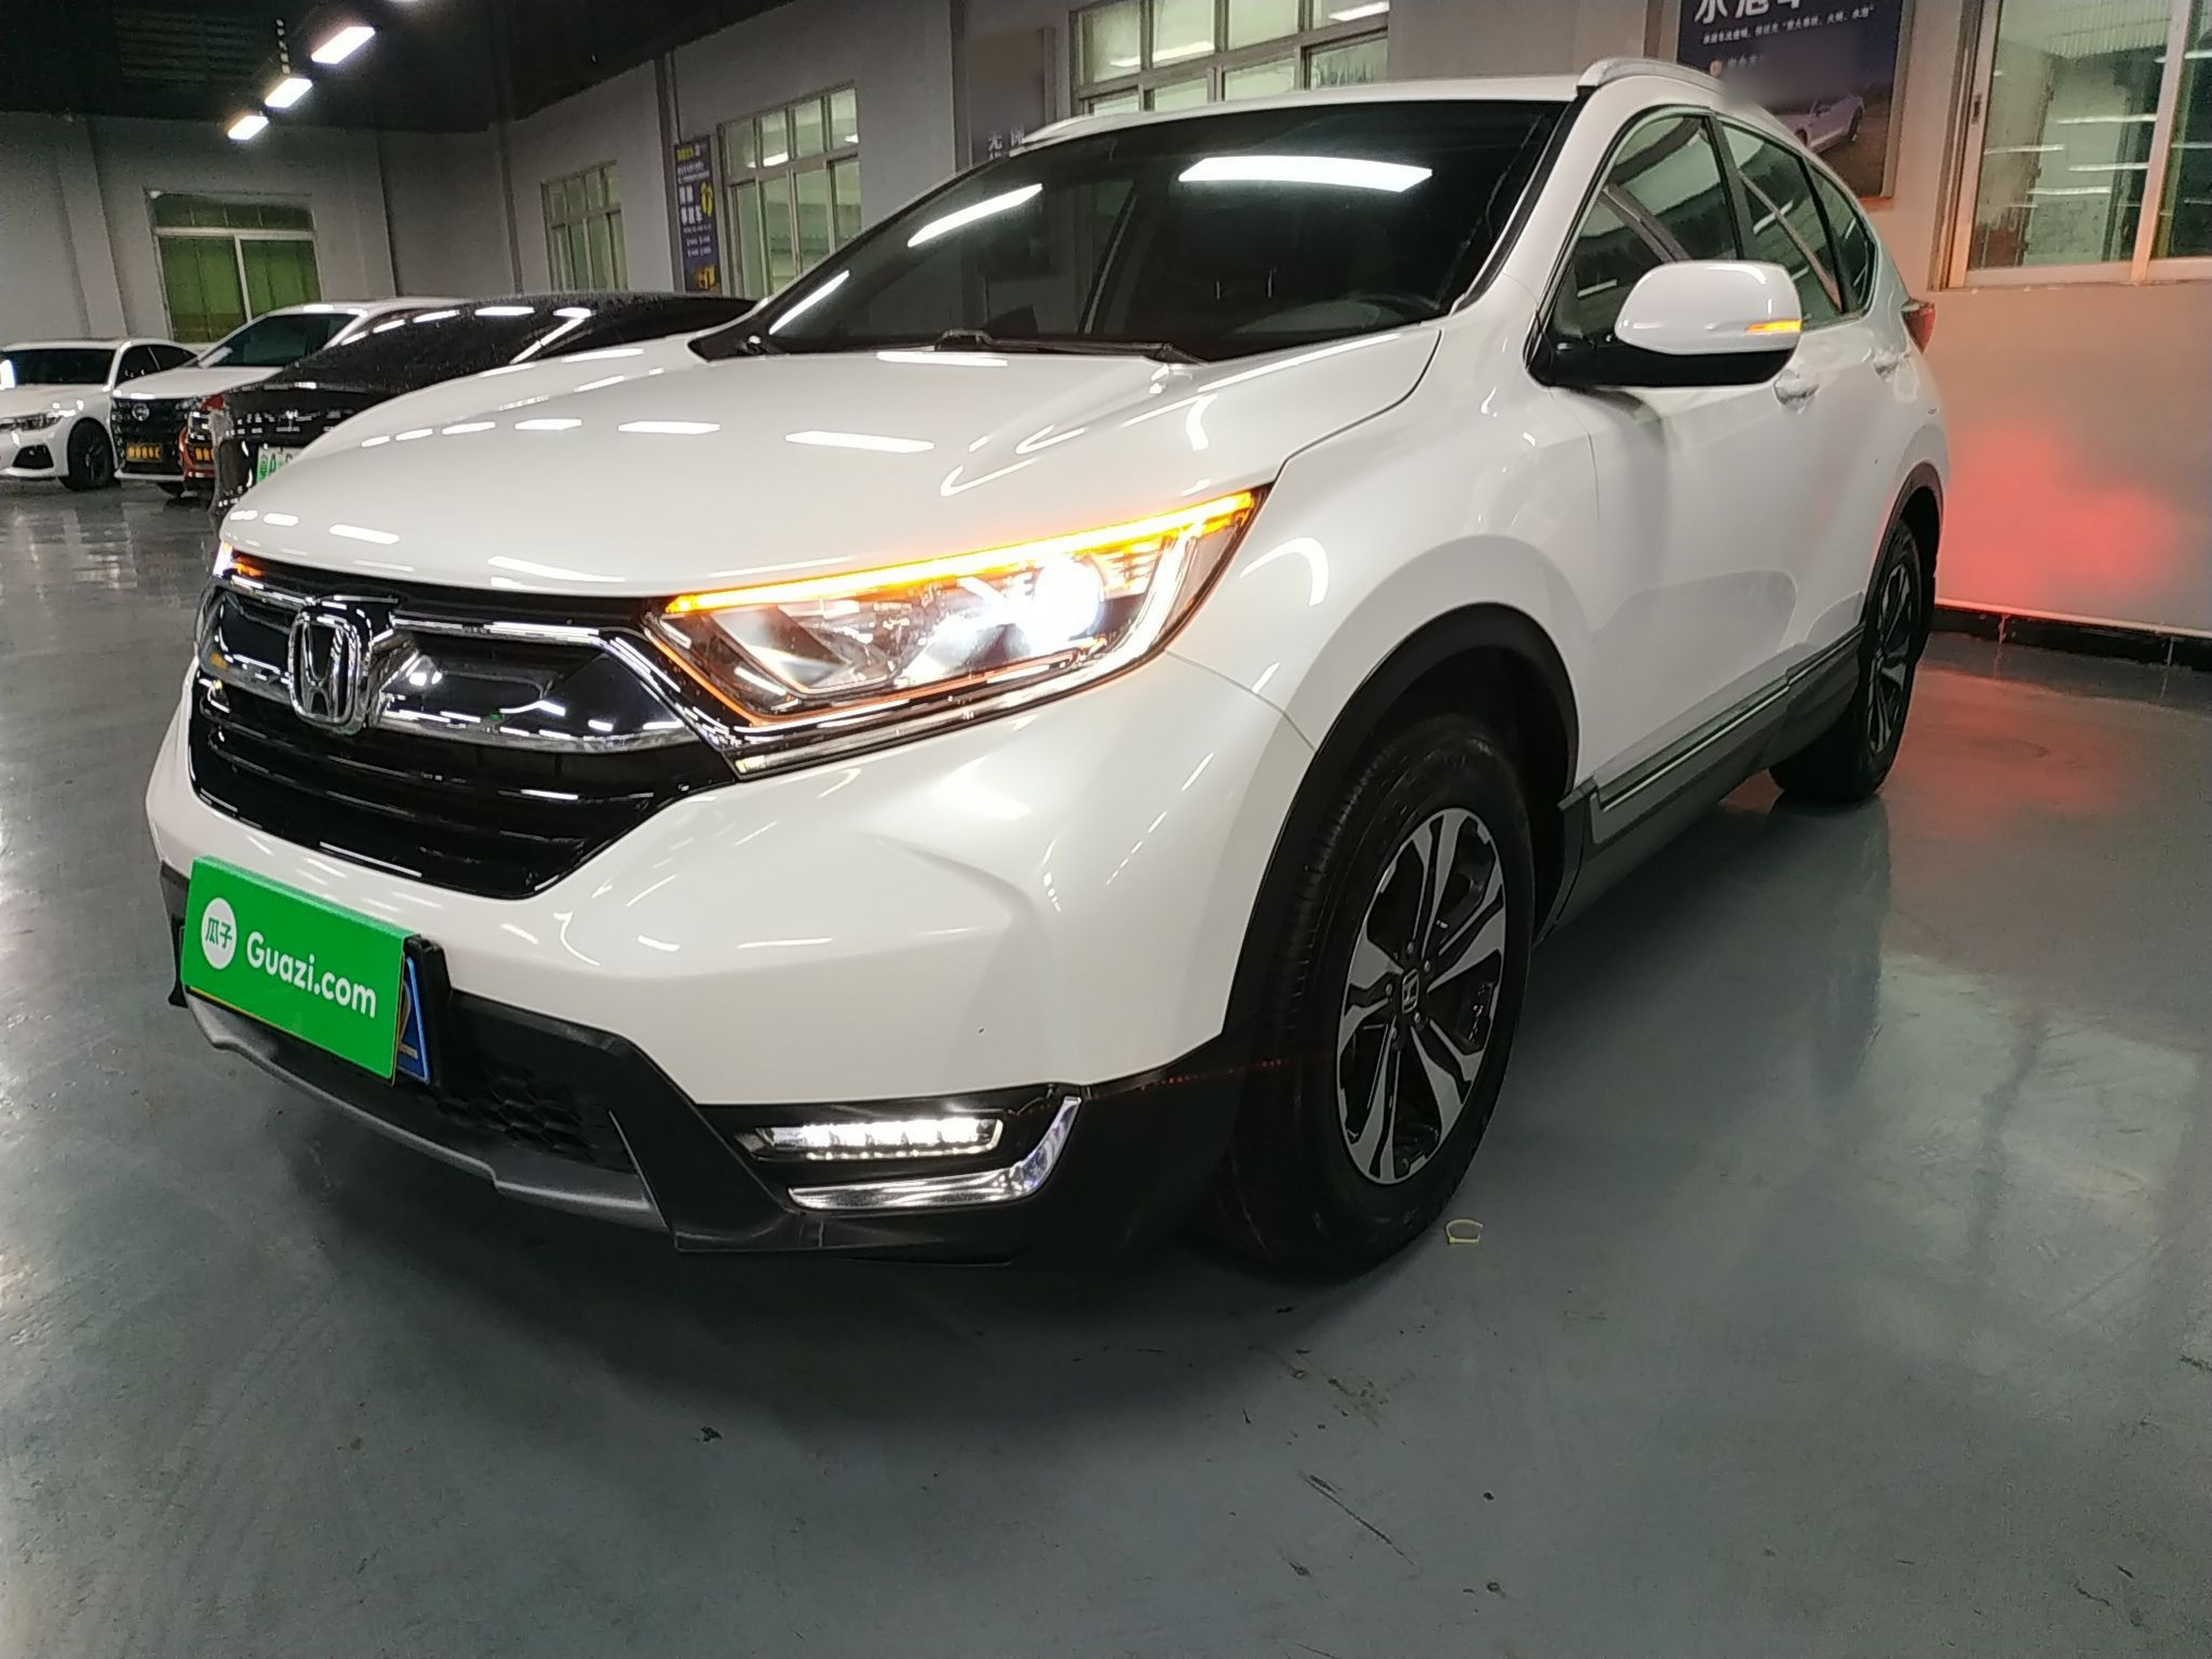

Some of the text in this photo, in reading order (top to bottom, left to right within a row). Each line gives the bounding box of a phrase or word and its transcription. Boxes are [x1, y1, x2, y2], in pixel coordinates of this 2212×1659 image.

[1695, 0, 1800, 24] 水泡
[205, 917, 232, 949] 瓜子
[247, 931, 376, 1018] Guazi.com
